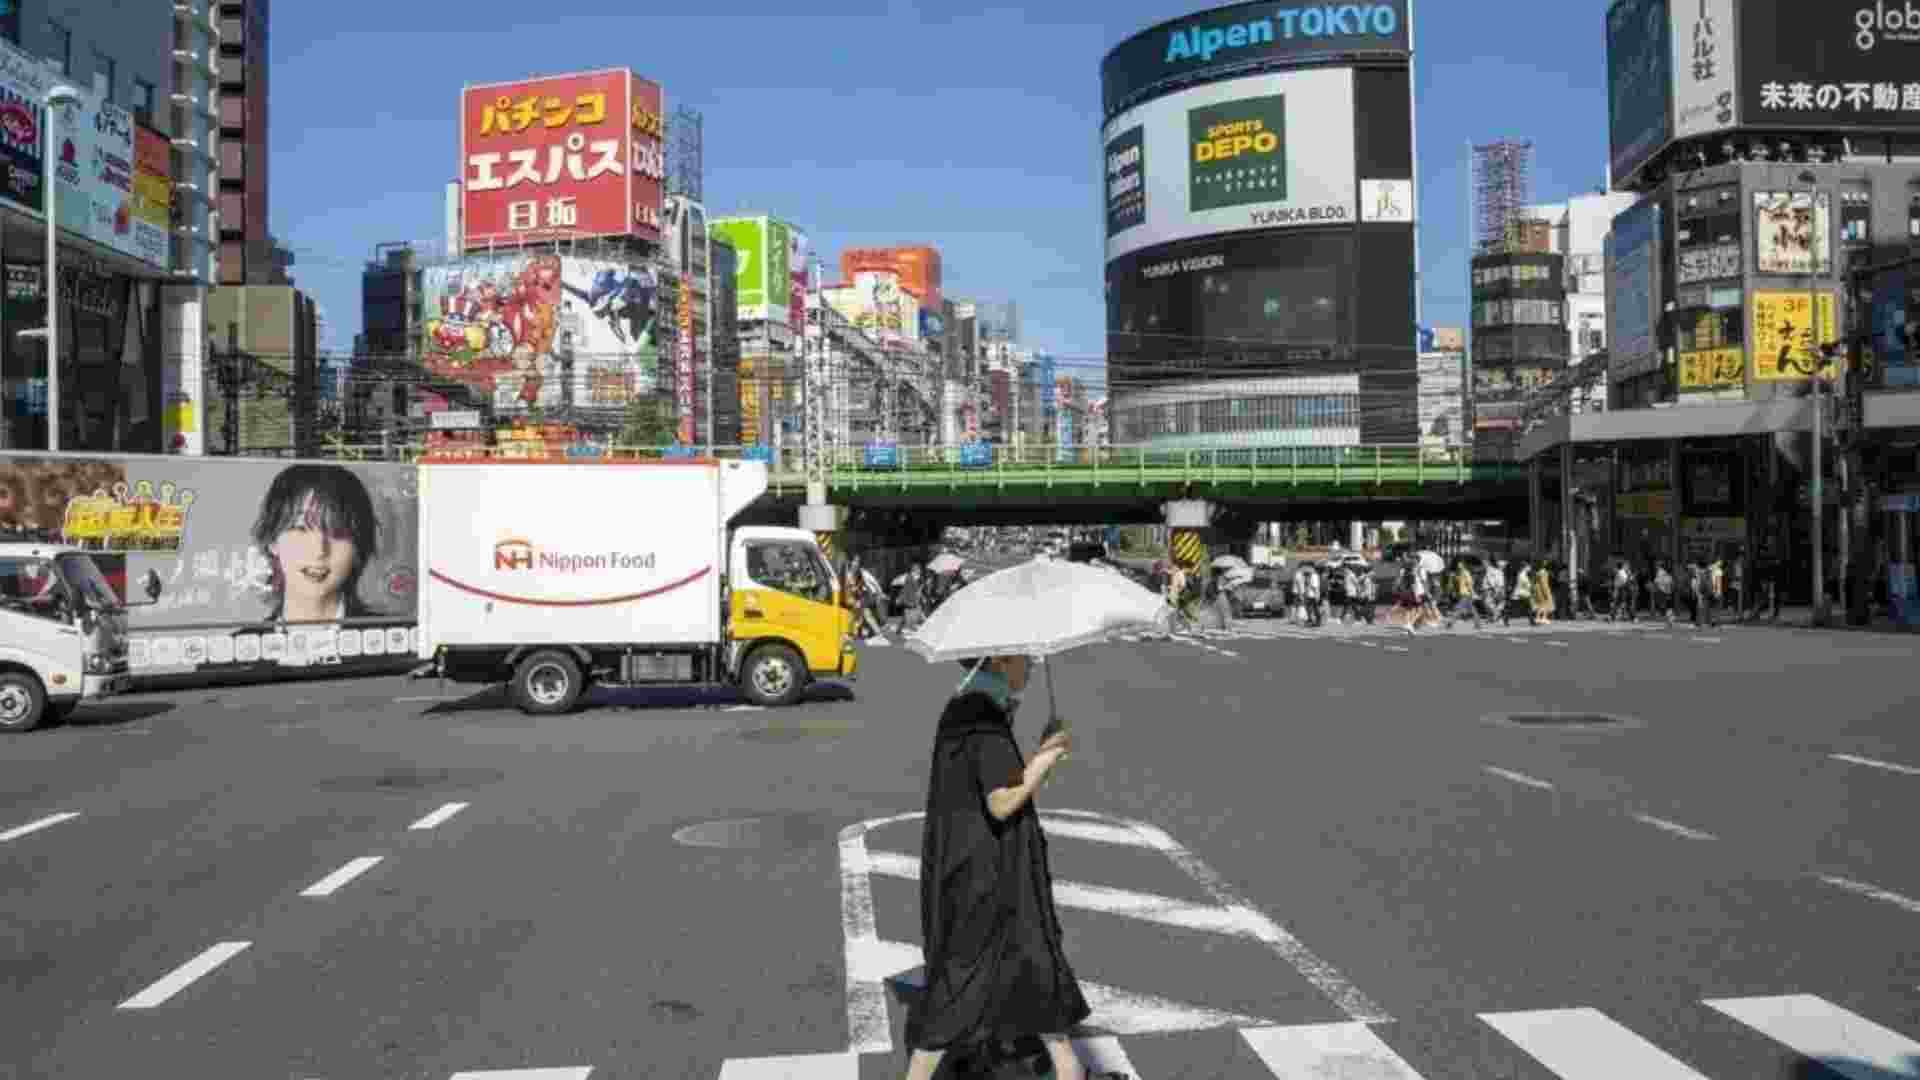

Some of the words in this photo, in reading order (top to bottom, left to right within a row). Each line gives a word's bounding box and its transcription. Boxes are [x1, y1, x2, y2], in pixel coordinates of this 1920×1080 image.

[1165, 17, 1273, 62] Alpen
[1277, 5, 1398, 38] TOKYO
[1760, 82, 1920, 111] 未来の不動産
[480, 93, 606, 136] パチンコ
[466, 132, 625, 192] エスパス
[1195, 131, 1279, 162] DEPO
[1250, 208, 1307, 225] YUNIKA
[539, 551, 606, 574] Nippon
[610, 551, 656, 570] Food
